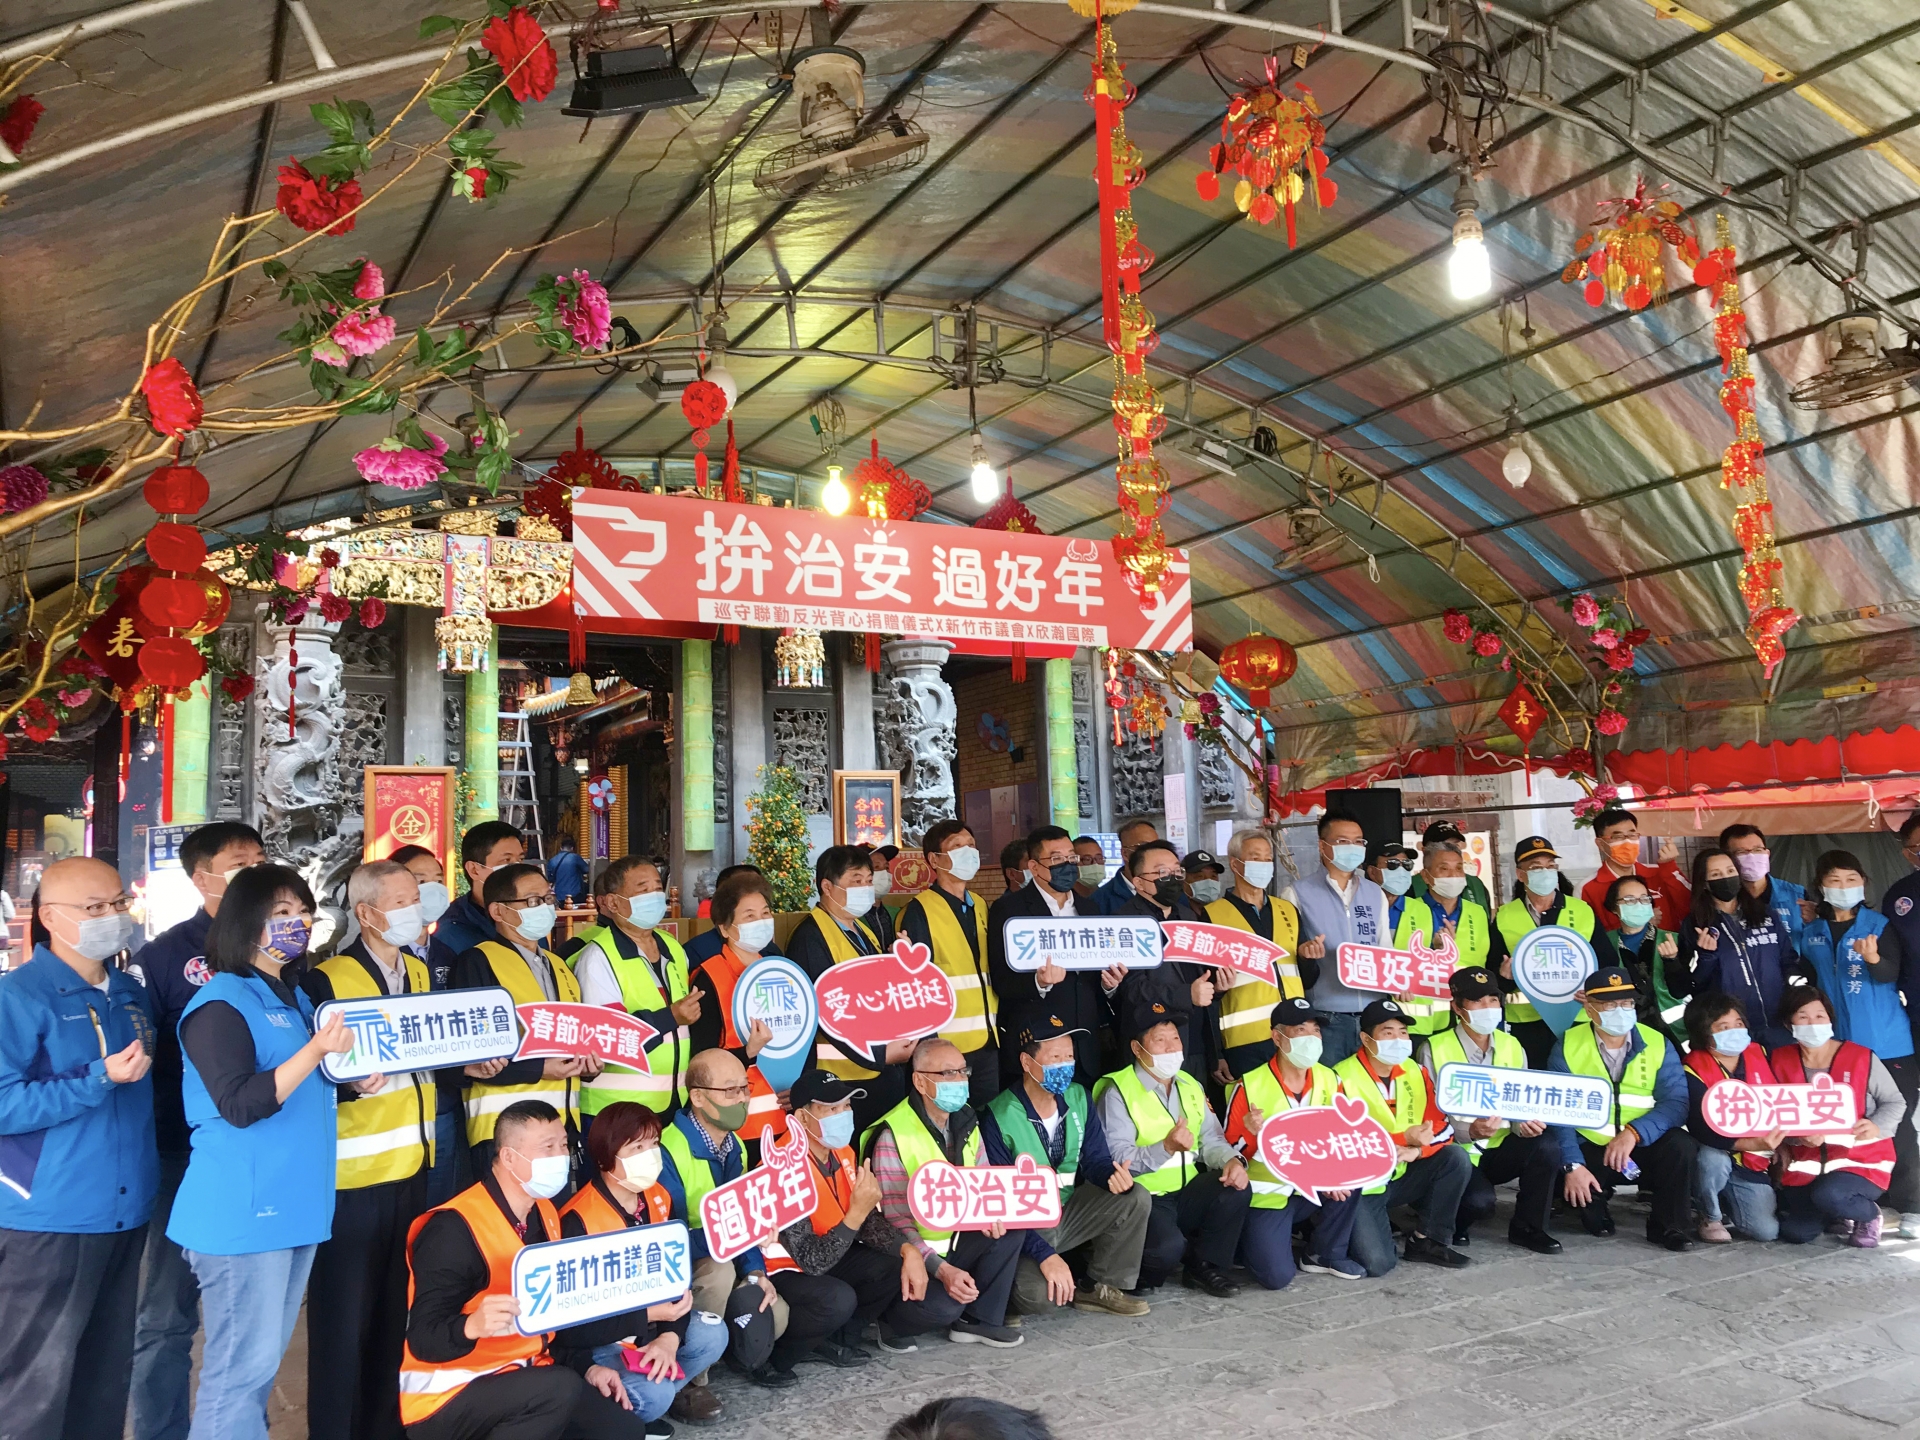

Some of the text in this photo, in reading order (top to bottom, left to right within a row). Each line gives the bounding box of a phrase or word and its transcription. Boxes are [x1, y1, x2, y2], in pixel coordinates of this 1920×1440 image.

[695, 510, 1106, 618] 拚治安 過好年
[106, 616, 146, 658] 春
[713, 602, 1096, 643] 巡守聯勤反光背心捐贈儀式X新竹市議會X欣瀚國際
[1513, 700, 1535, 726] 春
[395, 809, 426, 837] 金
[1038, 927, 1134, 950] 新竹市議會
[1080, 951, 1099, 960] CITY
[1101, 949, 1136, 959] COUNCIL
[1172, 924, 1273, 974] 春節 守護
[1344, 946, 1450, 996] 過好年
[823, 977, 948, 1022] 愛心相挺
[400, 1005, 511, 1044] 新竹市議會
[530, 1007, 641, 1060] 春節 守護
[404, 1034, 514, 1059] HSINCHU CITY COUNCIL
[1501, 1104, 1602, 1121] HSINCHU CITY COUNCIL
[1502, 1081, 1604, 1112] 新竹市議會
[1715, 1087, 1846, 1126] 拚治安
[1269, 1130, 1389, 1166] 愛心相挺
[707, 1161, 812, 1256] 過好年
[920, 1168, 1051, 1219] 拚治安
[556, 1241, 662, 1294] 新竹市議會
[556, 1277, 664, 1310] HSINCHU CITY COUNCIL
